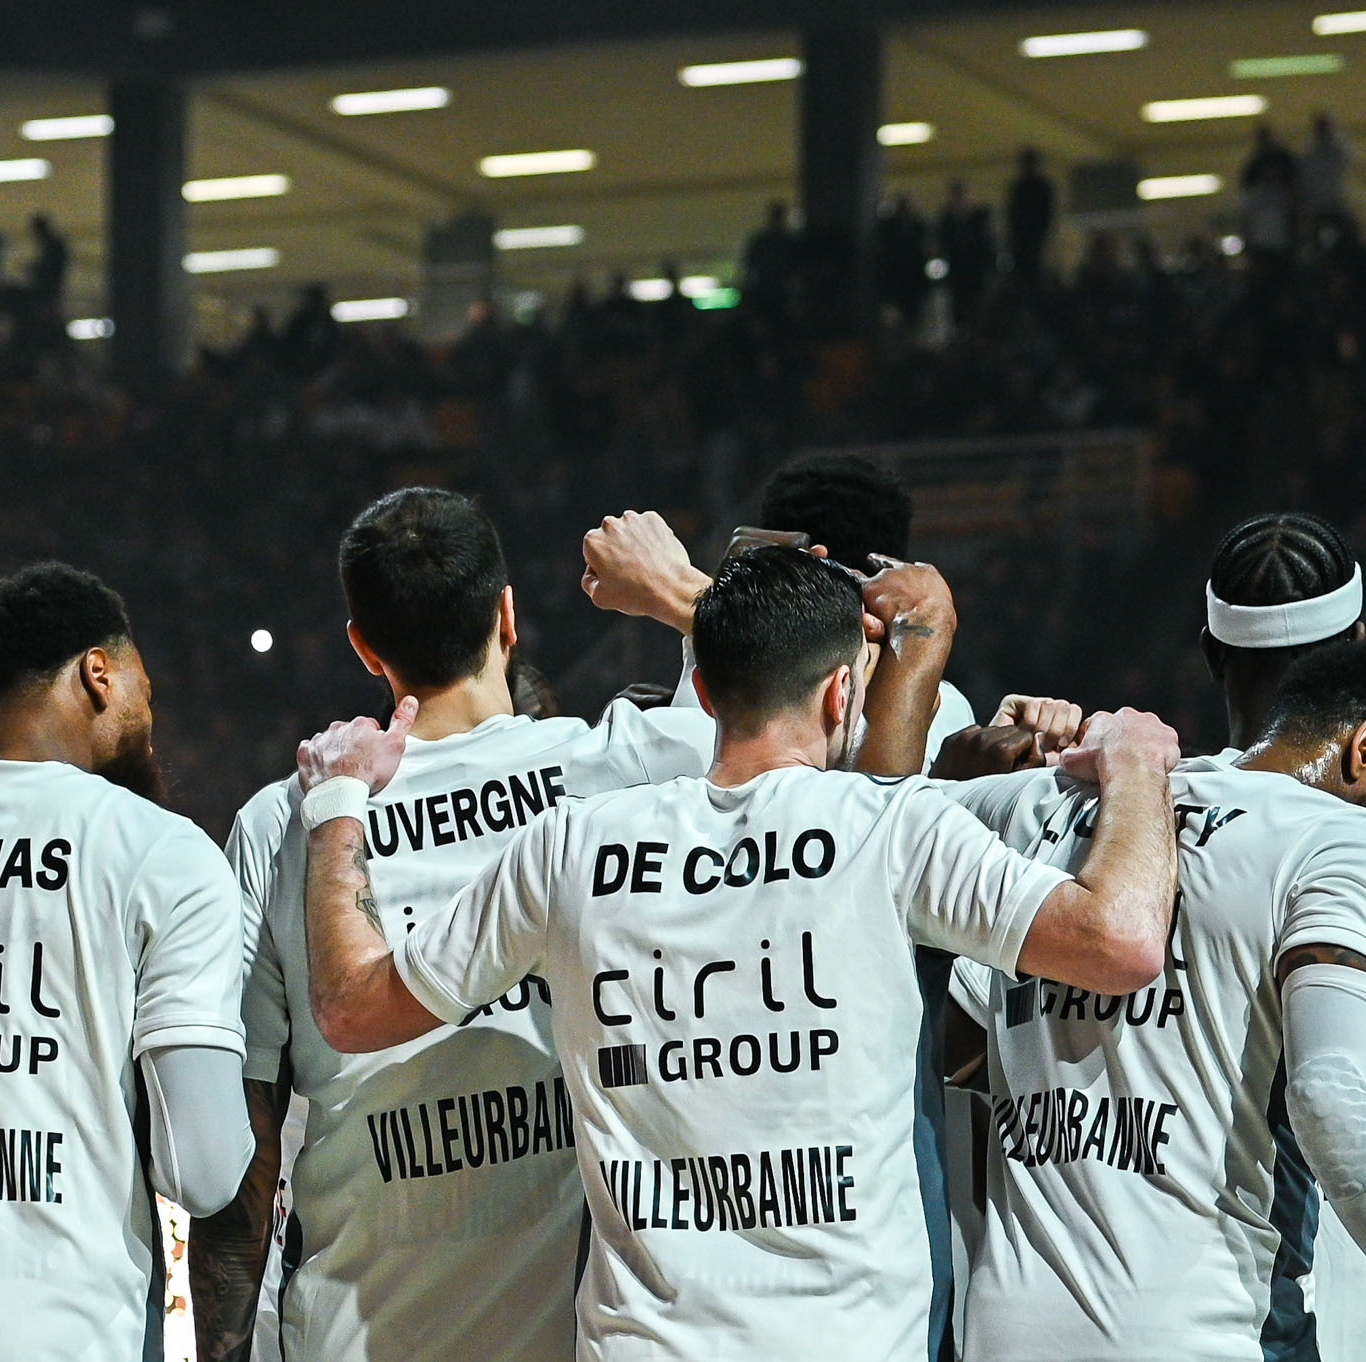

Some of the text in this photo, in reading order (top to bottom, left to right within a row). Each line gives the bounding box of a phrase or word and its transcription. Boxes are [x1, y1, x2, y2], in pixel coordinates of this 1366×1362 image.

[591, 828, 836, 897] DE COLO
[594, 931, 838, 1027] ciril
[658, 1029, 839, 1082] GROUP
[599, 1145, 856, 1232] VILLEURBANNE
